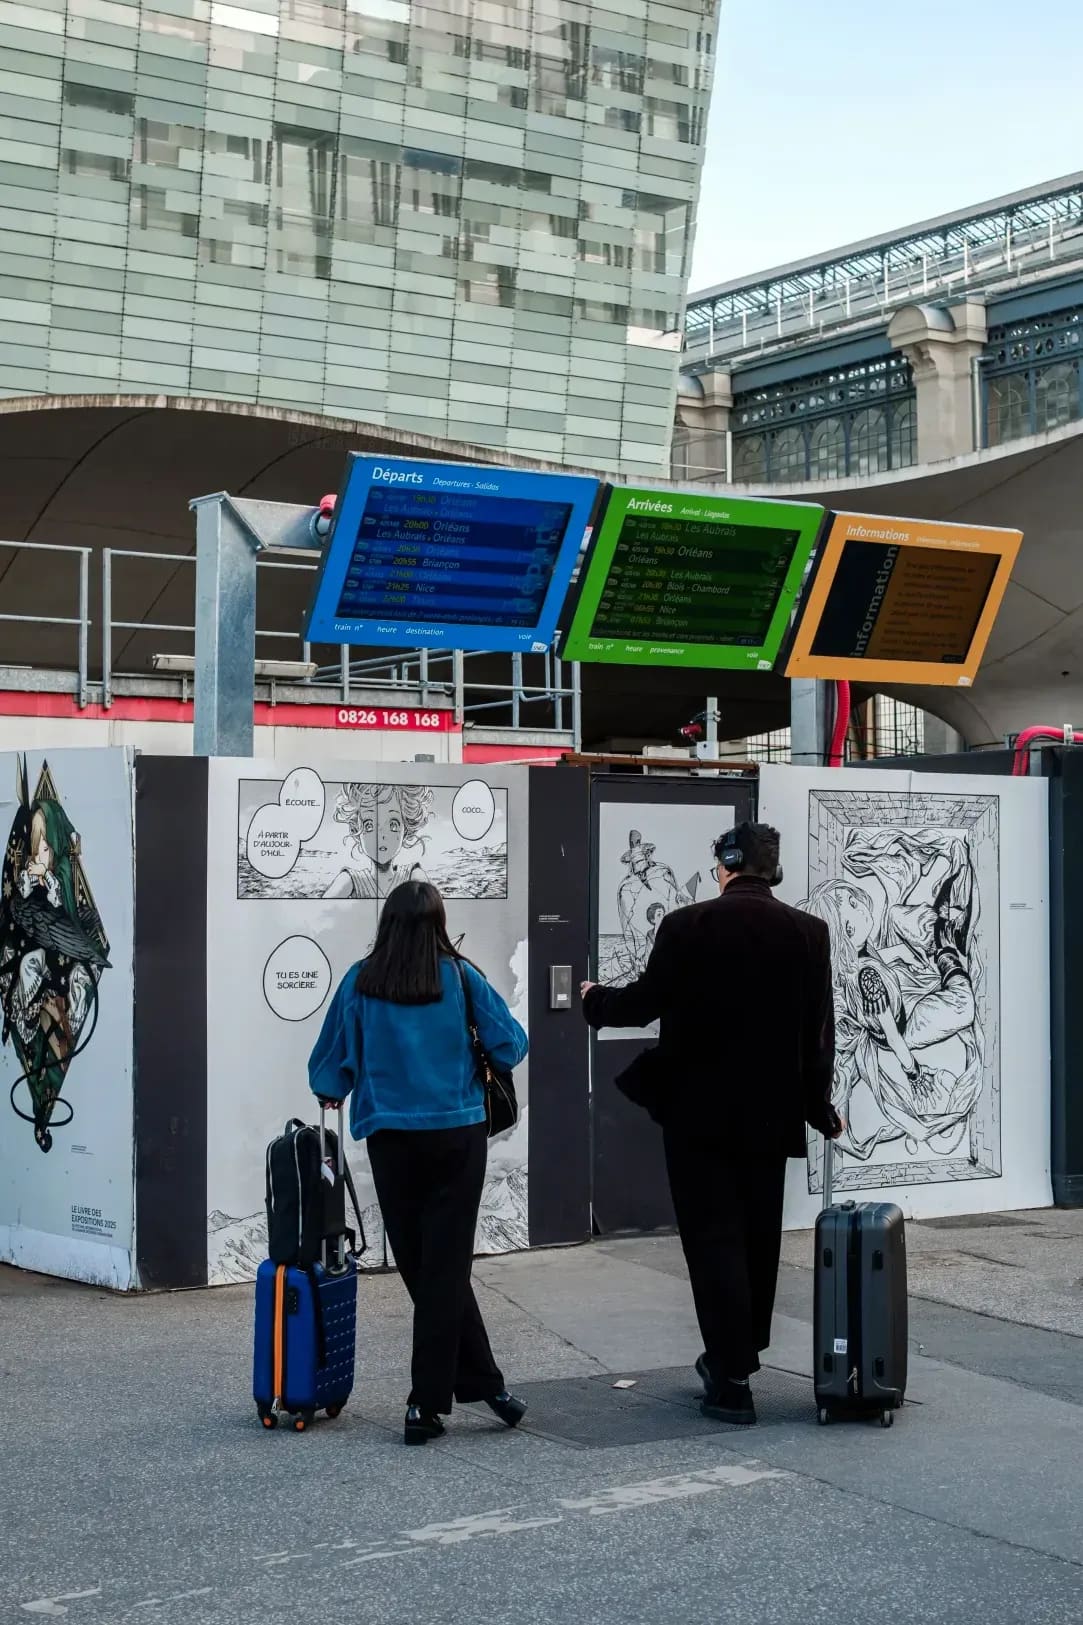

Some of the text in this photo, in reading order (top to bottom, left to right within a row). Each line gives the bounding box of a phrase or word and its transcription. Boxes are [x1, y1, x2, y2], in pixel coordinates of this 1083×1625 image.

[372, 467, 424, 484] Départs
[626, 497, 673, 513] Arrivées
[403, 519, 430, 530] 20h00
[432, 520, 471, 533] Orléans
[684, 522, 701, 533] Les
[703, 523, 738, 537] Aubrais
[846, 524, 910, 542] Informations
[376, 528, 392, 538] Les
[433, 533, 466, 545] Orléans
[678, 544, 714, 559] Orléans
[422, 558, 461, 570] Briançon
[628, 554, 660, 566] Orléans
[415, 583, 436, 593] Nice
[691, 583, 731, 595] Chambord
[849, 546, 899, 657] information
[334, 623, 351, 632] train
[376, 625, 398, 634] heure
[405, 626, 445, 637] destination
[518, 633, 533, 641] voie
[588, 642, 604, 651] train
[625, 645, 644, 653] heure
[649, 647, 685, 656] provenance
[338, 709, 440, 727] 0826 168 168
[265, 831, 289, 839] PARTIR
[276, 971, 319, 979] TU ES UNE
[71, 1204, 77, 1213] LE
[91, 1208, 102, 1217] DES
[71, 1214, 104, 1227] EXPOSITIONS
